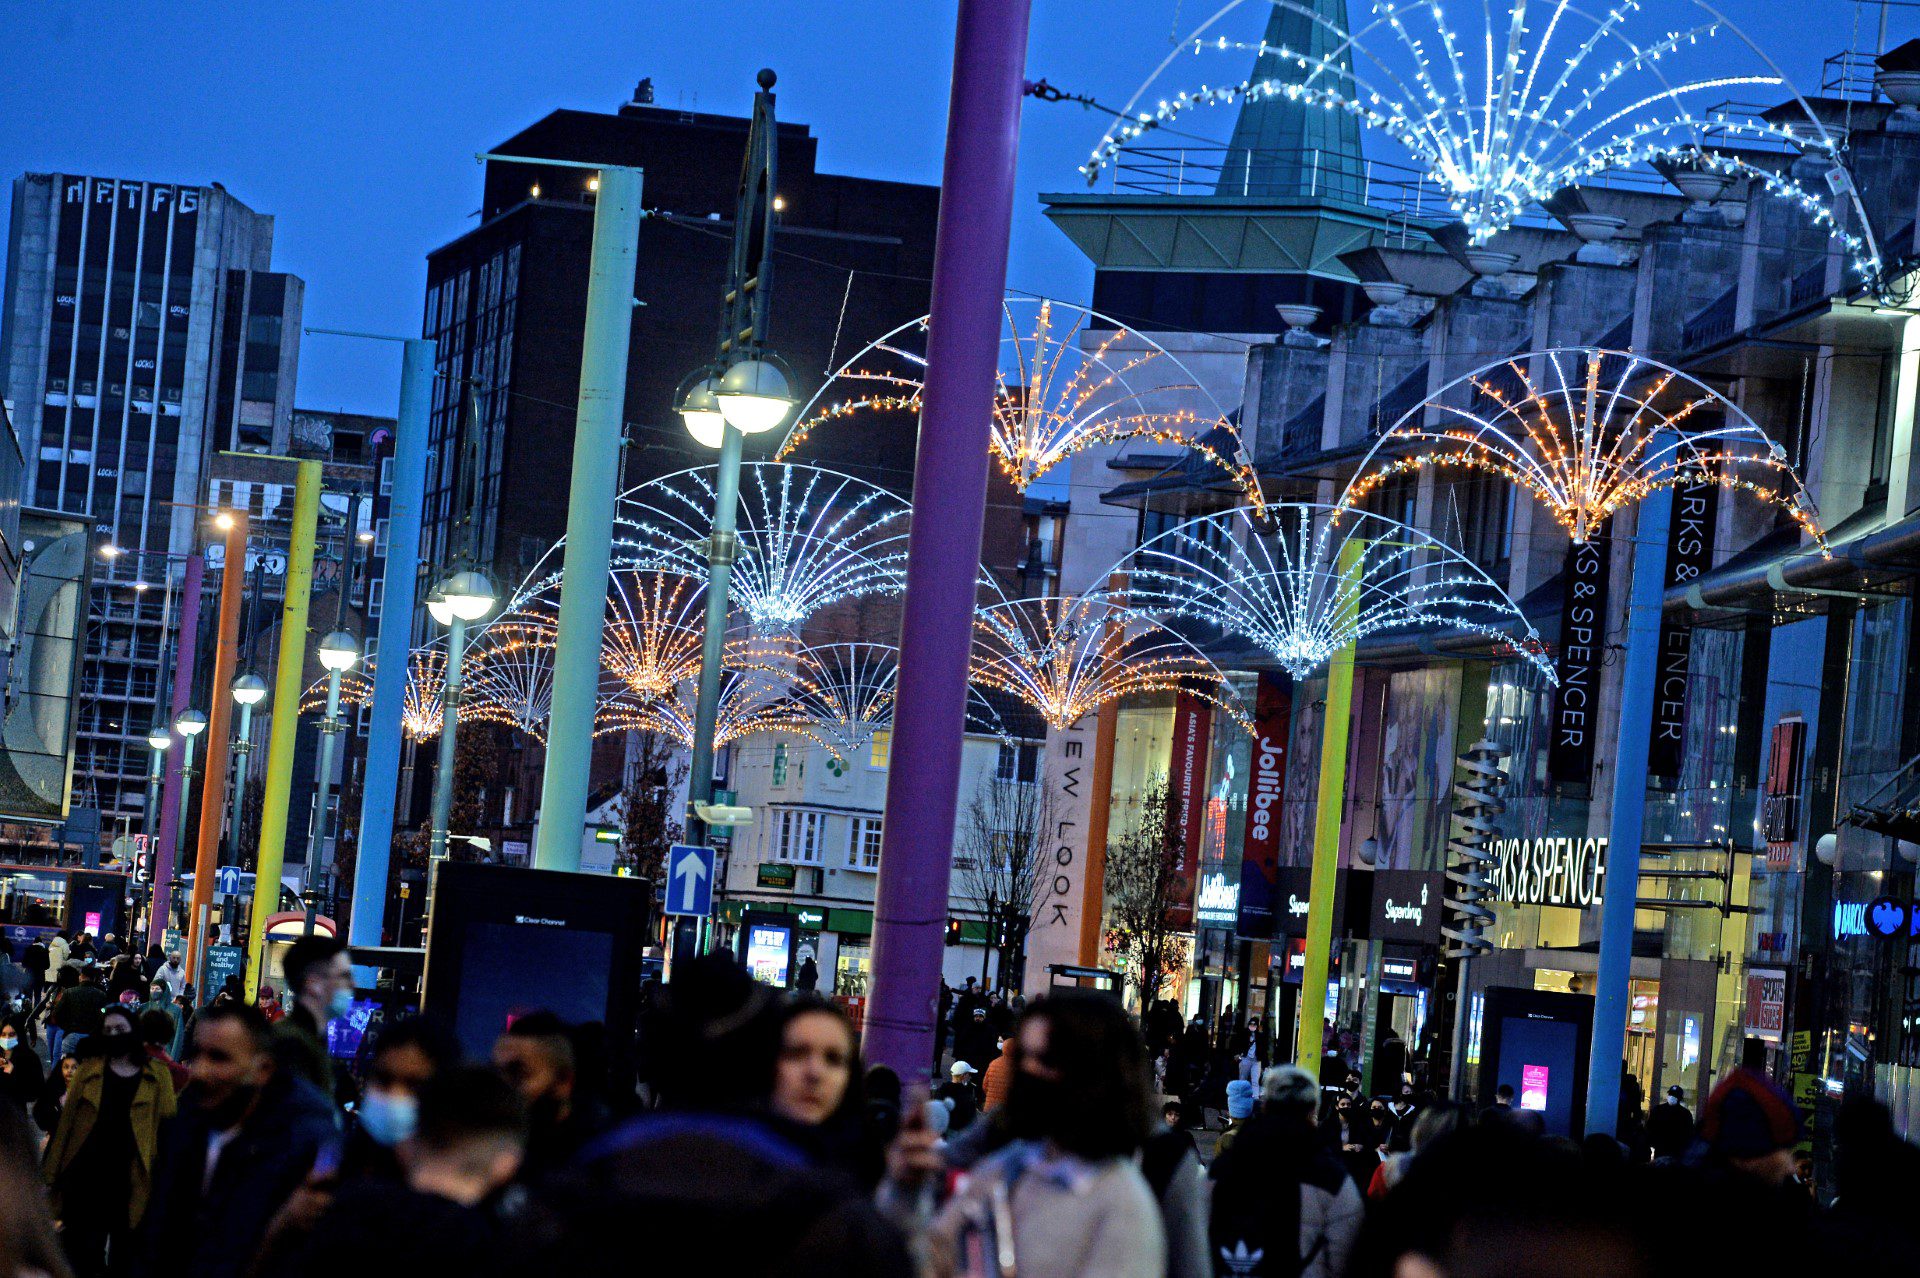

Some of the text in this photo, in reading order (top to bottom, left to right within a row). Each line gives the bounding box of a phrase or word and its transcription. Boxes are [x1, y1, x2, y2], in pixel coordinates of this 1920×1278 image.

[1574, 582, 1596, 599] &
[1675, 563, 1699, 582] &
[1561, 606, 1594, 747] SPENCER
[1659, 627, 1690, 740] ENCER
[1187, 711, 1198, 742] ASIA'S
[1182, 744, 1195, 797] FAVOURITE
[1252, 736, 1283, 841] Jollibee
[1051, 821, 1076, 926] LOOK
[1518, 839, 1529, 903] &
[1530, 838, 1608, 905] SPENCE
[1289, 894, 1310, 917] Super
[1385, 899, 1422, 926] Superdrug
[210, 961, 235, 969] healthy
